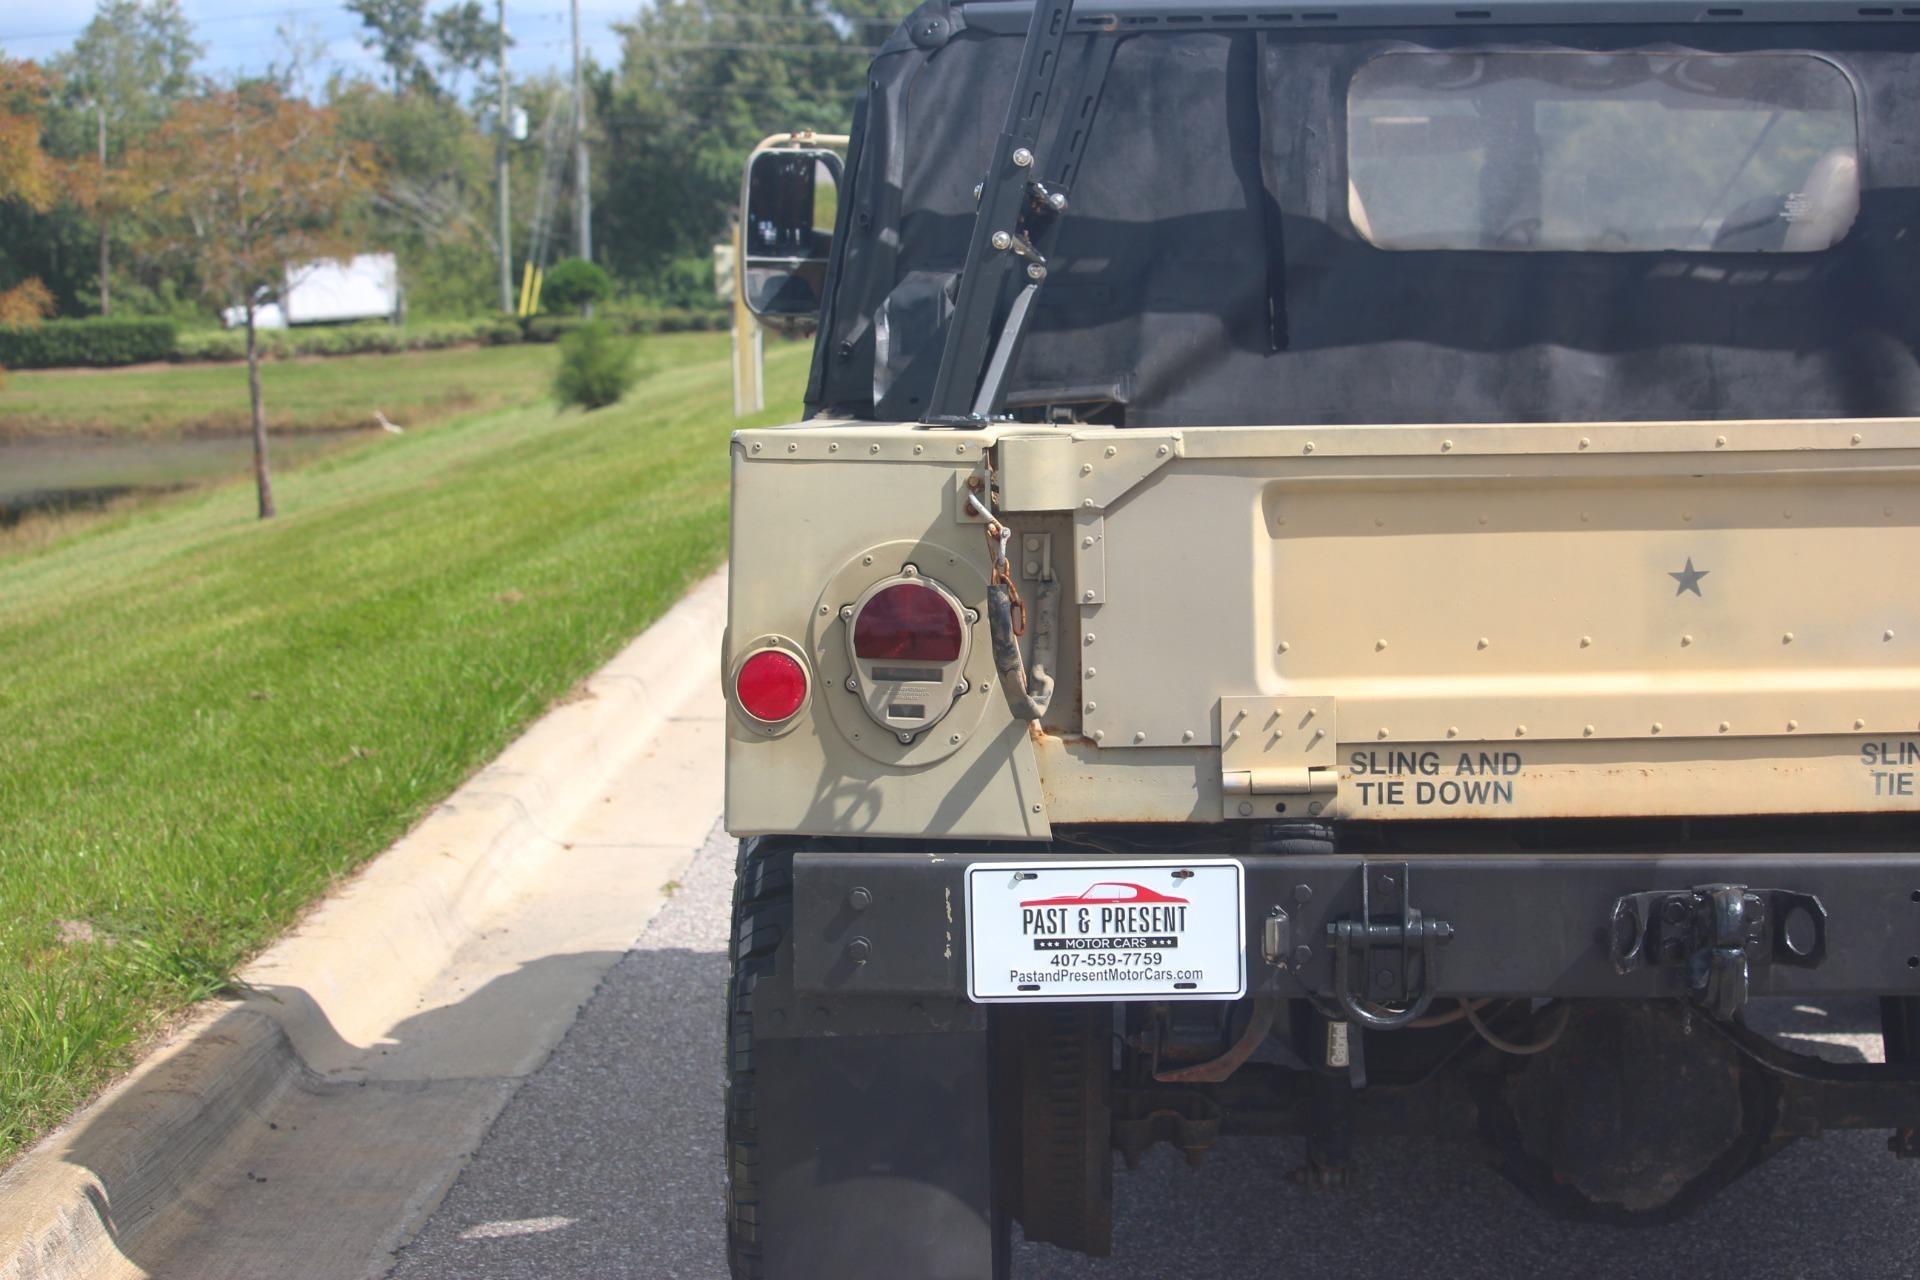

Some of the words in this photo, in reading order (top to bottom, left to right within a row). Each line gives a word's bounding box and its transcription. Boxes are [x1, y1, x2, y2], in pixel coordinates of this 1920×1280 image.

[1350, 752, 1440, 775] SLING
[1455, 752, 1522, 775] AND
[1356, 782, 1404, 805] TIE
[1416, 781, 1513, 805] DOWN
[1871, 772, 1914, 796] TIE
[1023, 908, 1067, 935] PAST
[1078, 907, 1091, 933] &
[1102, 906, 1187, 932] PRESENT
[1065, 939, 1110, 949] MOTOR
[1113, 938, 1147, 948] CARS
[1050, 953, 1163, 966] 407-559-7759
[1010, 968, 1203, 982] PastandPresentMotorCars.com
